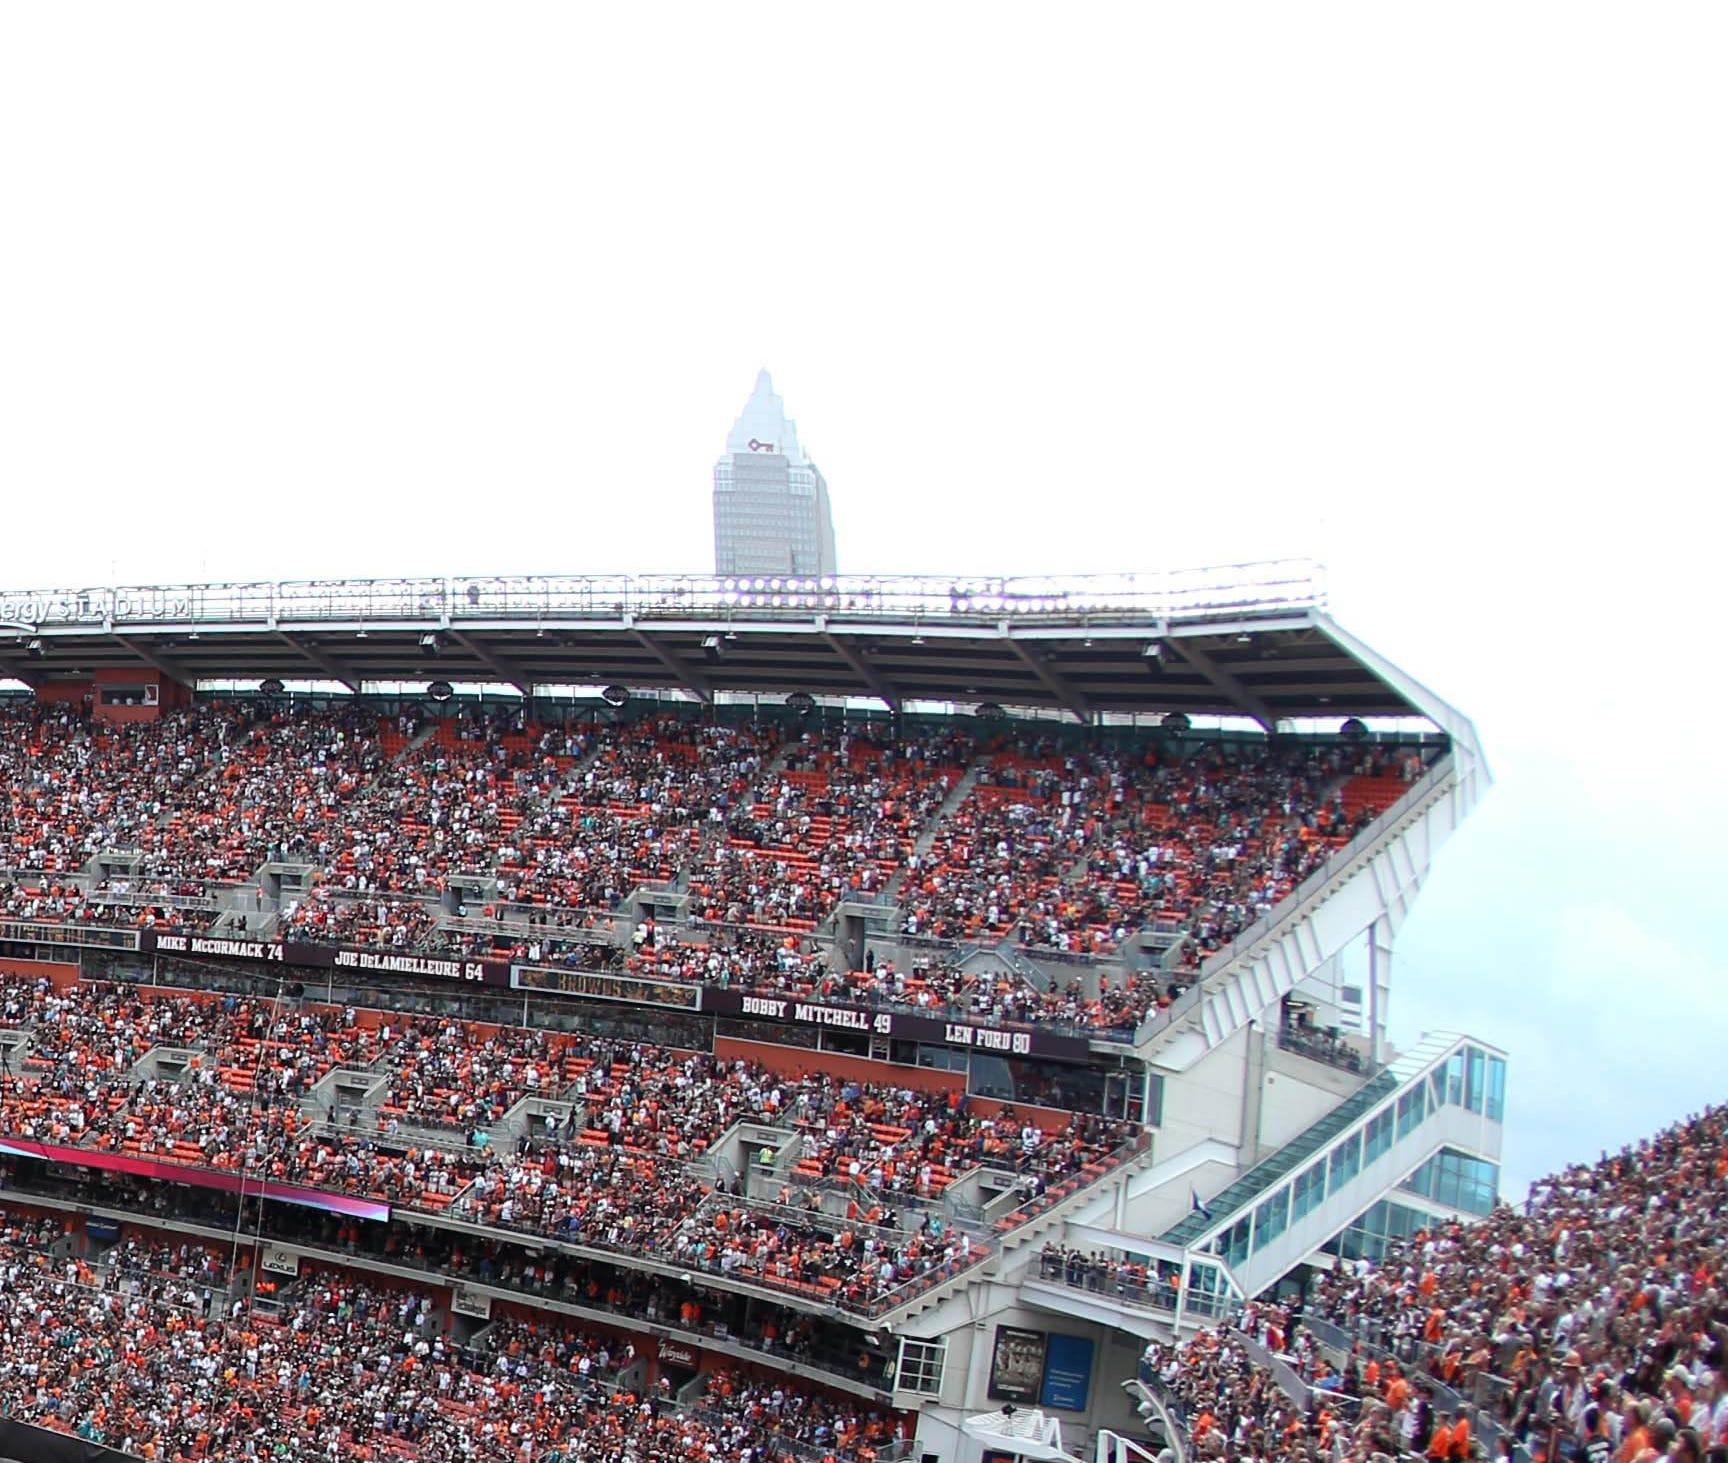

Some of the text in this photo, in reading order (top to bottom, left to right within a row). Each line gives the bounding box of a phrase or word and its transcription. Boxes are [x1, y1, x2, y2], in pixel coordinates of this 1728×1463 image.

[58, 596, 191, 620] STADIUM
[157, 935, 186, 951] MIKE
[191, 938, 263, 958] McCORMACK
[267, 944, 284, 961] 74
[334, 951, 358, 967] JOE
[465, 963, 484, 981] 64
[742, 996, 891, 1034] BOBBY MITCHELL 49
[945, 1024, 1031, 1055] LEN FORD 80
[263, 1261, 296, 1274] LEXUS
